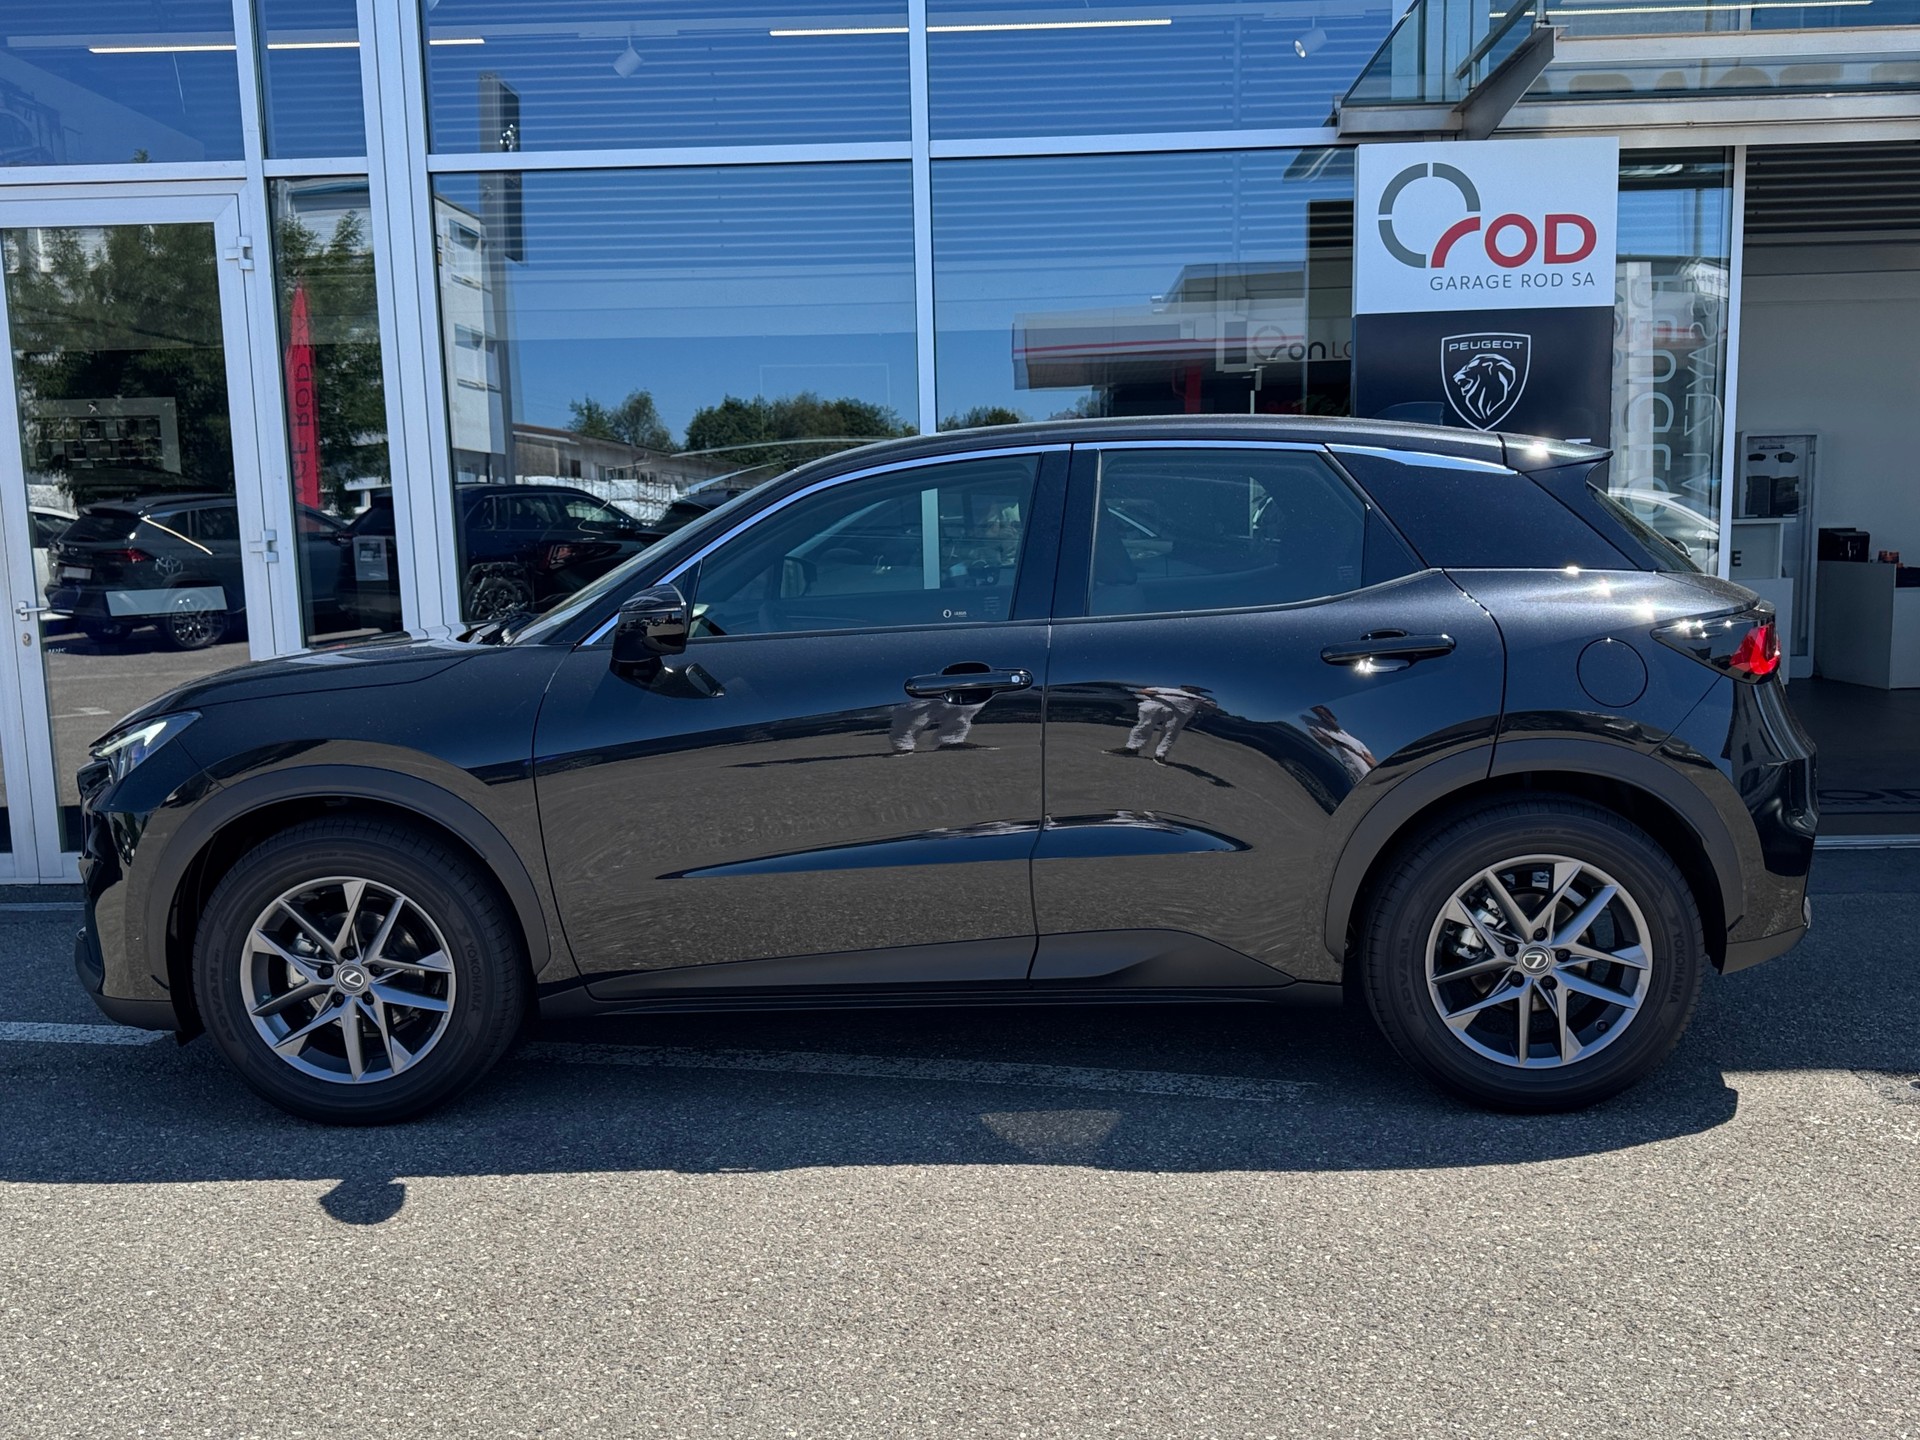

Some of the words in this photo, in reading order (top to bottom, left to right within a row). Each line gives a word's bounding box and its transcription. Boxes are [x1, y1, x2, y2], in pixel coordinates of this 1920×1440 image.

[1430, 274, 1512, 291] GARAGE
[1521, 272, 1563, 288] ROD
[1572, 271, 1595, 287] SA
[1448, 340, 1523, 352] PEUGEOT
[465, 941, 482, 1012] YOKOHAMA
[1400, 938, 1418, 1016] ADVAN
[1668, 931, 1685, 1003] YOKOHAMA
[209, 966, 238, 1041] ADVAN
